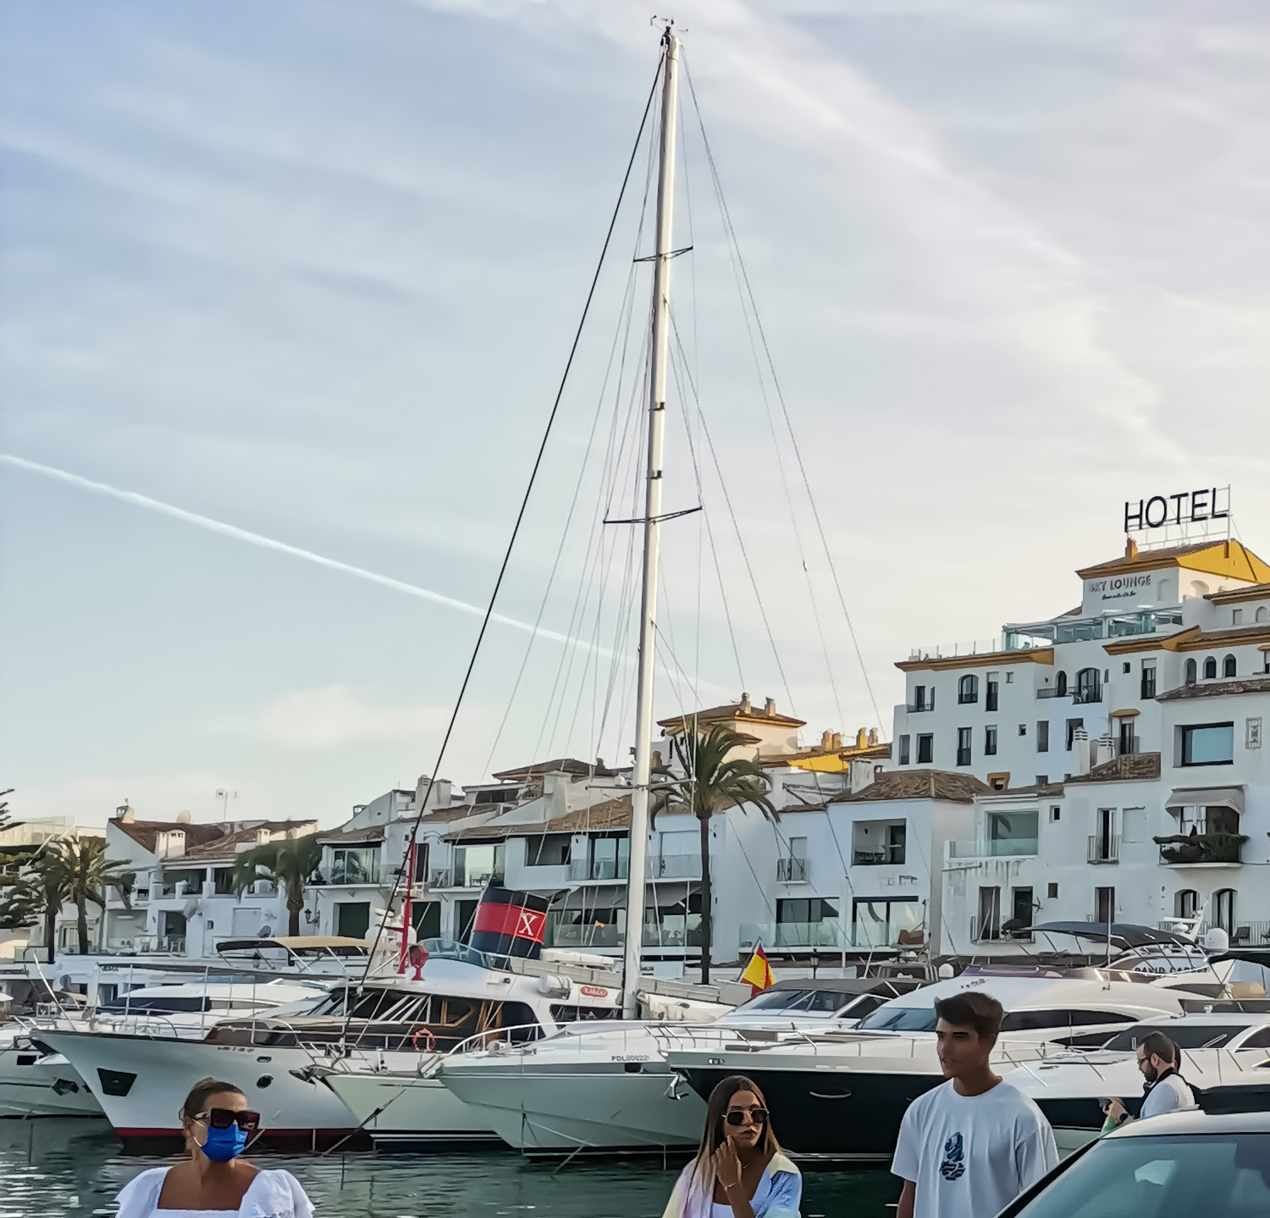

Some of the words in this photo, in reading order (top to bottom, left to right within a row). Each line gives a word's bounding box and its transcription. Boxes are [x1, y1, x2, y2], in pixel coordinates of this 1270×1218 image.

[1124, 487, 1228, 533] HOTEL
[1110, 574, 1151, 591] LOUNGE
[519, 912, 538, 936] X
